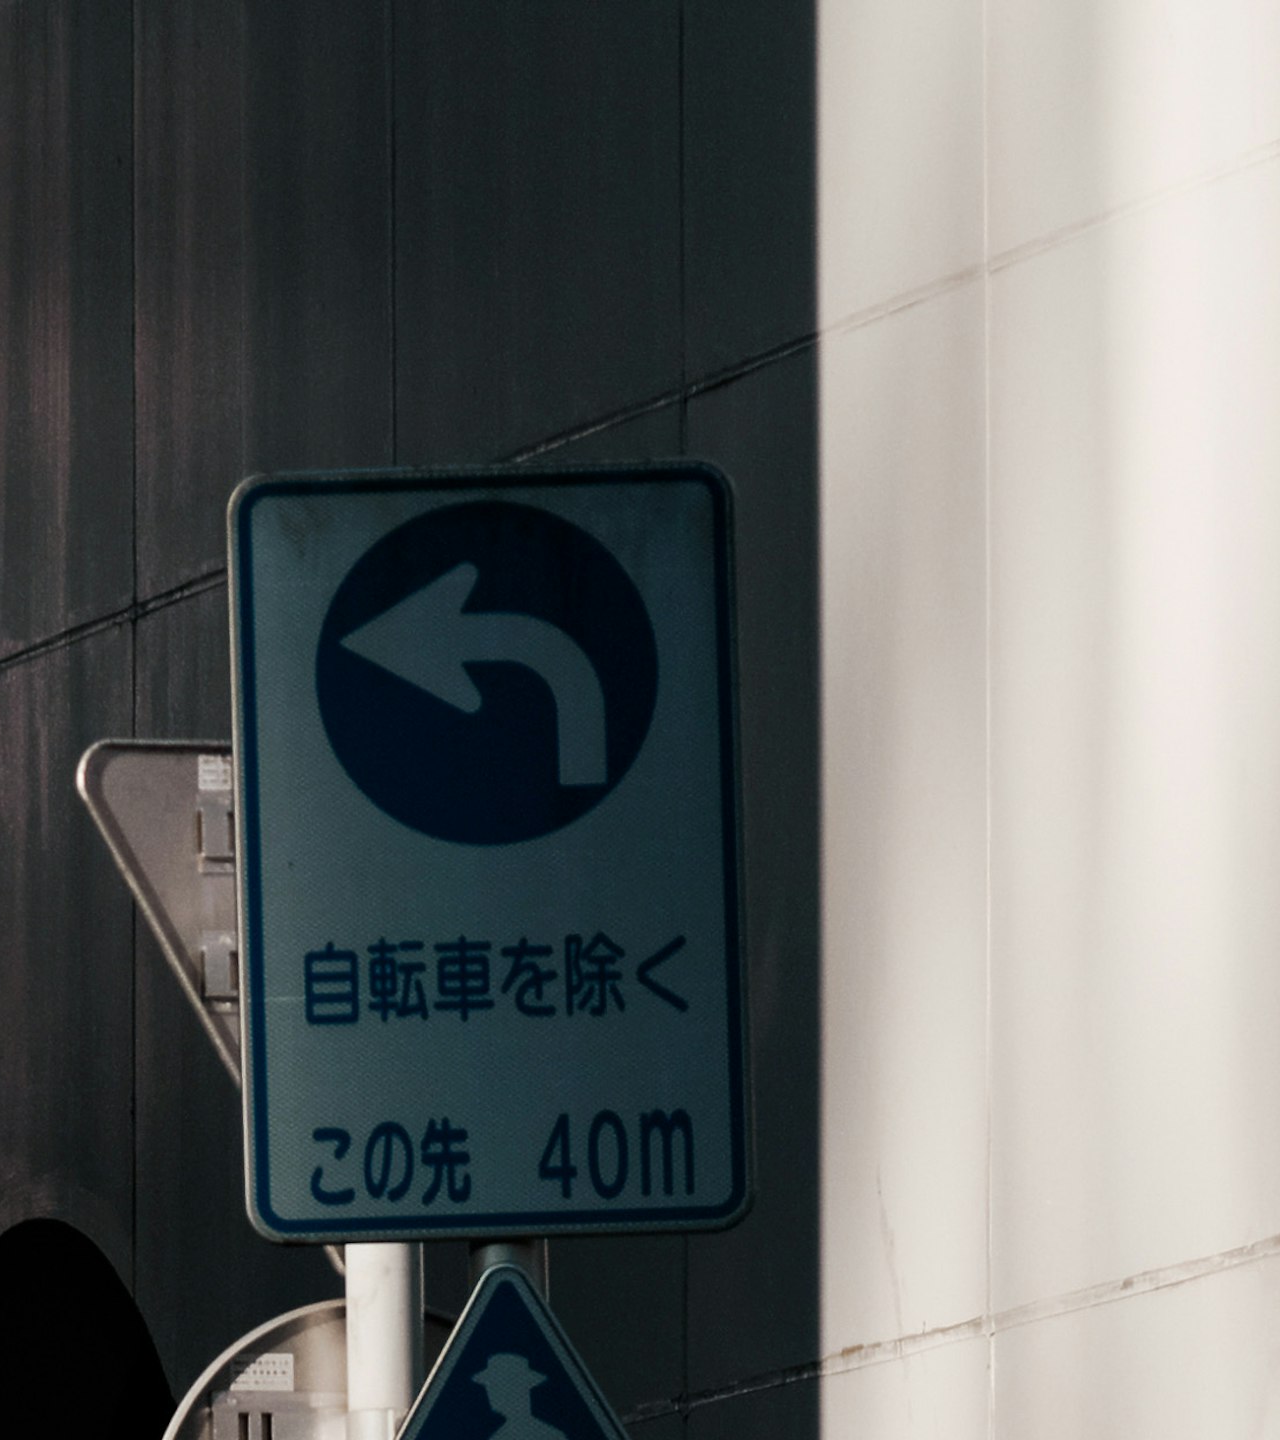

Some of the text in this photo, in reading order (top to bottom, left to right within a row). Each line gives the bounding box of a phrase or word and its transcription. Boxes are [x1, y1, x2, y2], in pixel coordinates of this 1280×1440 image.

[304, 932, 689, 1025] 自転車を除く
[310, 1108, 696, 1206] この先 40m
